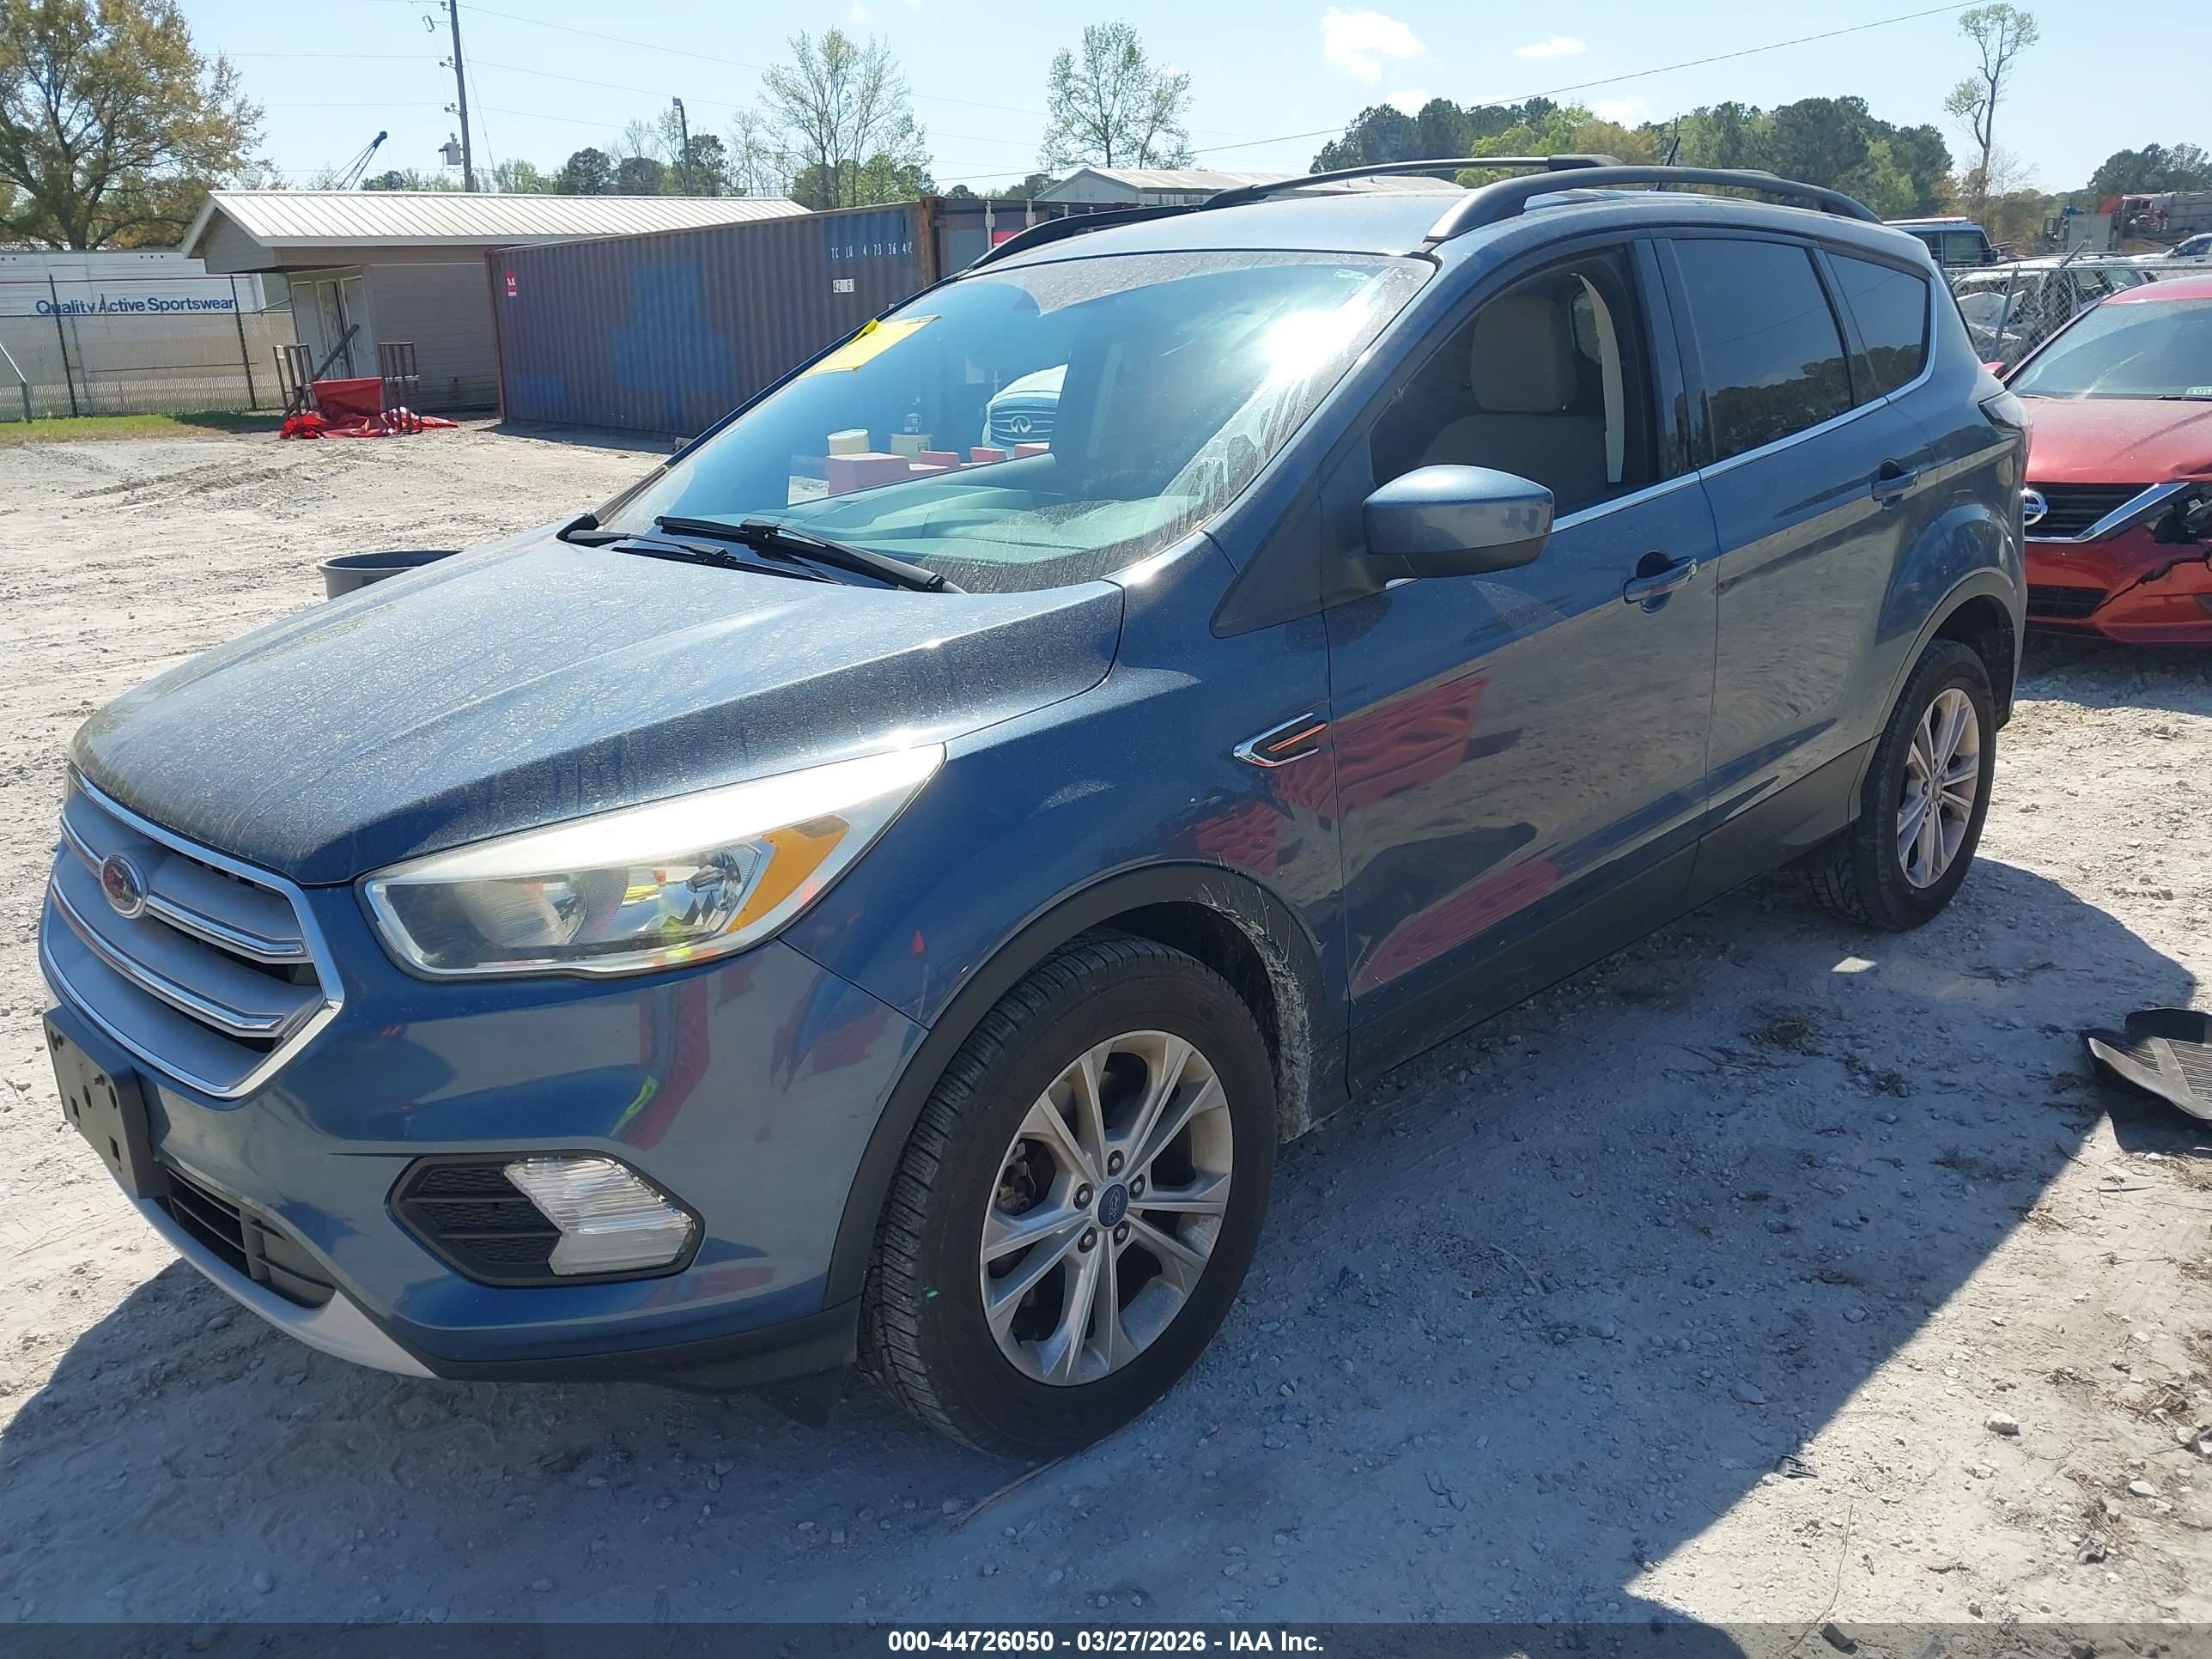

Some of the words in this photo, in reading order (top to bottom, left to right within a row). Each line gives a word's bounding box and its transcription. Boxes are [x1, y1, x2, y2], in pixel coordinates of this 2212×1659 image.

[35, 299, 96, 314] Quality
[99, 297, 145, 313] Active
[147, 297, 234, 313] Sportswear
